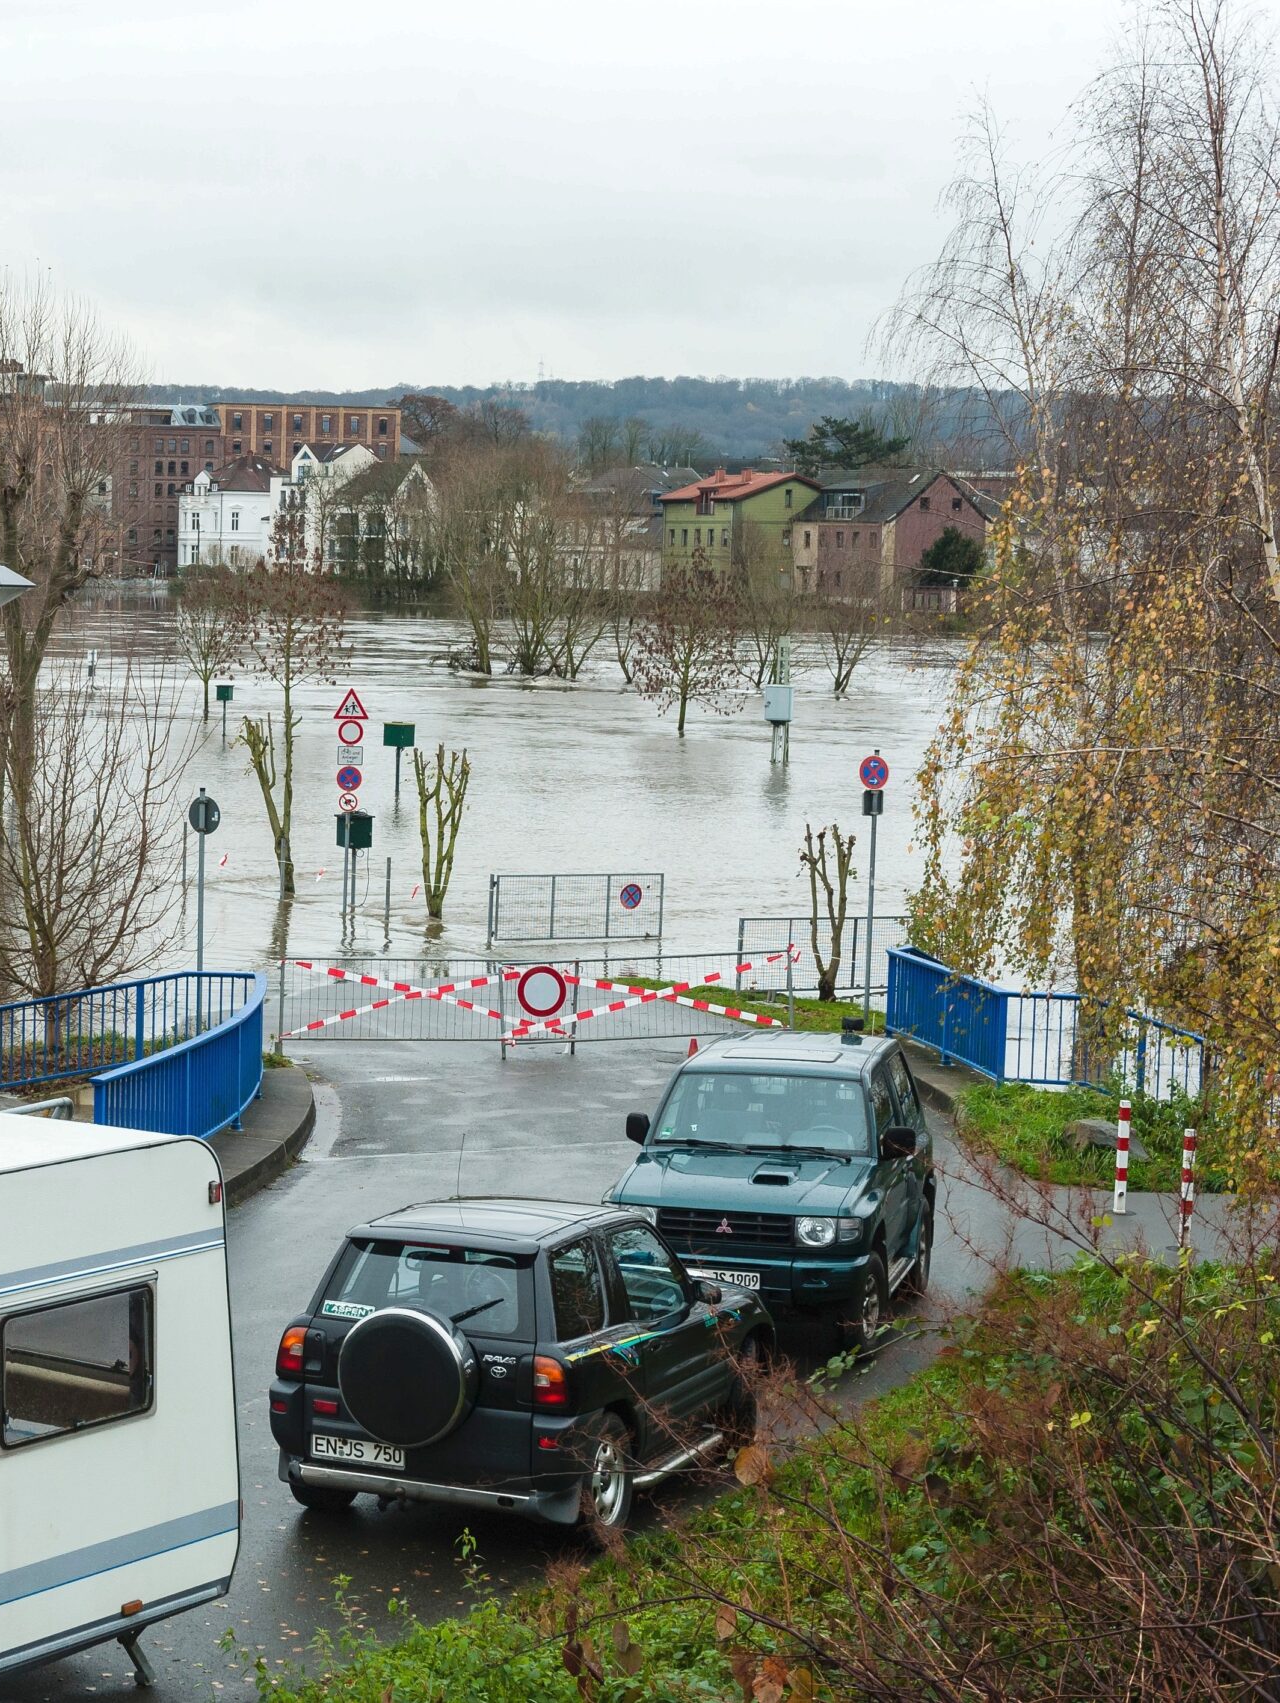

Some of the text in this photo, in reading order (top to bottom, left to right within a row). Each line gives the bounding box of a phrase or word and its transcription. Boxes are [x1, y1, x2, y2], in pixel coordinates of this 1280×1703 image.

[729, 1273, 758, 1287] 1909
[331, 1304, 366, 1316] ASPEN
[374, 1444, 402, 1463] 750
